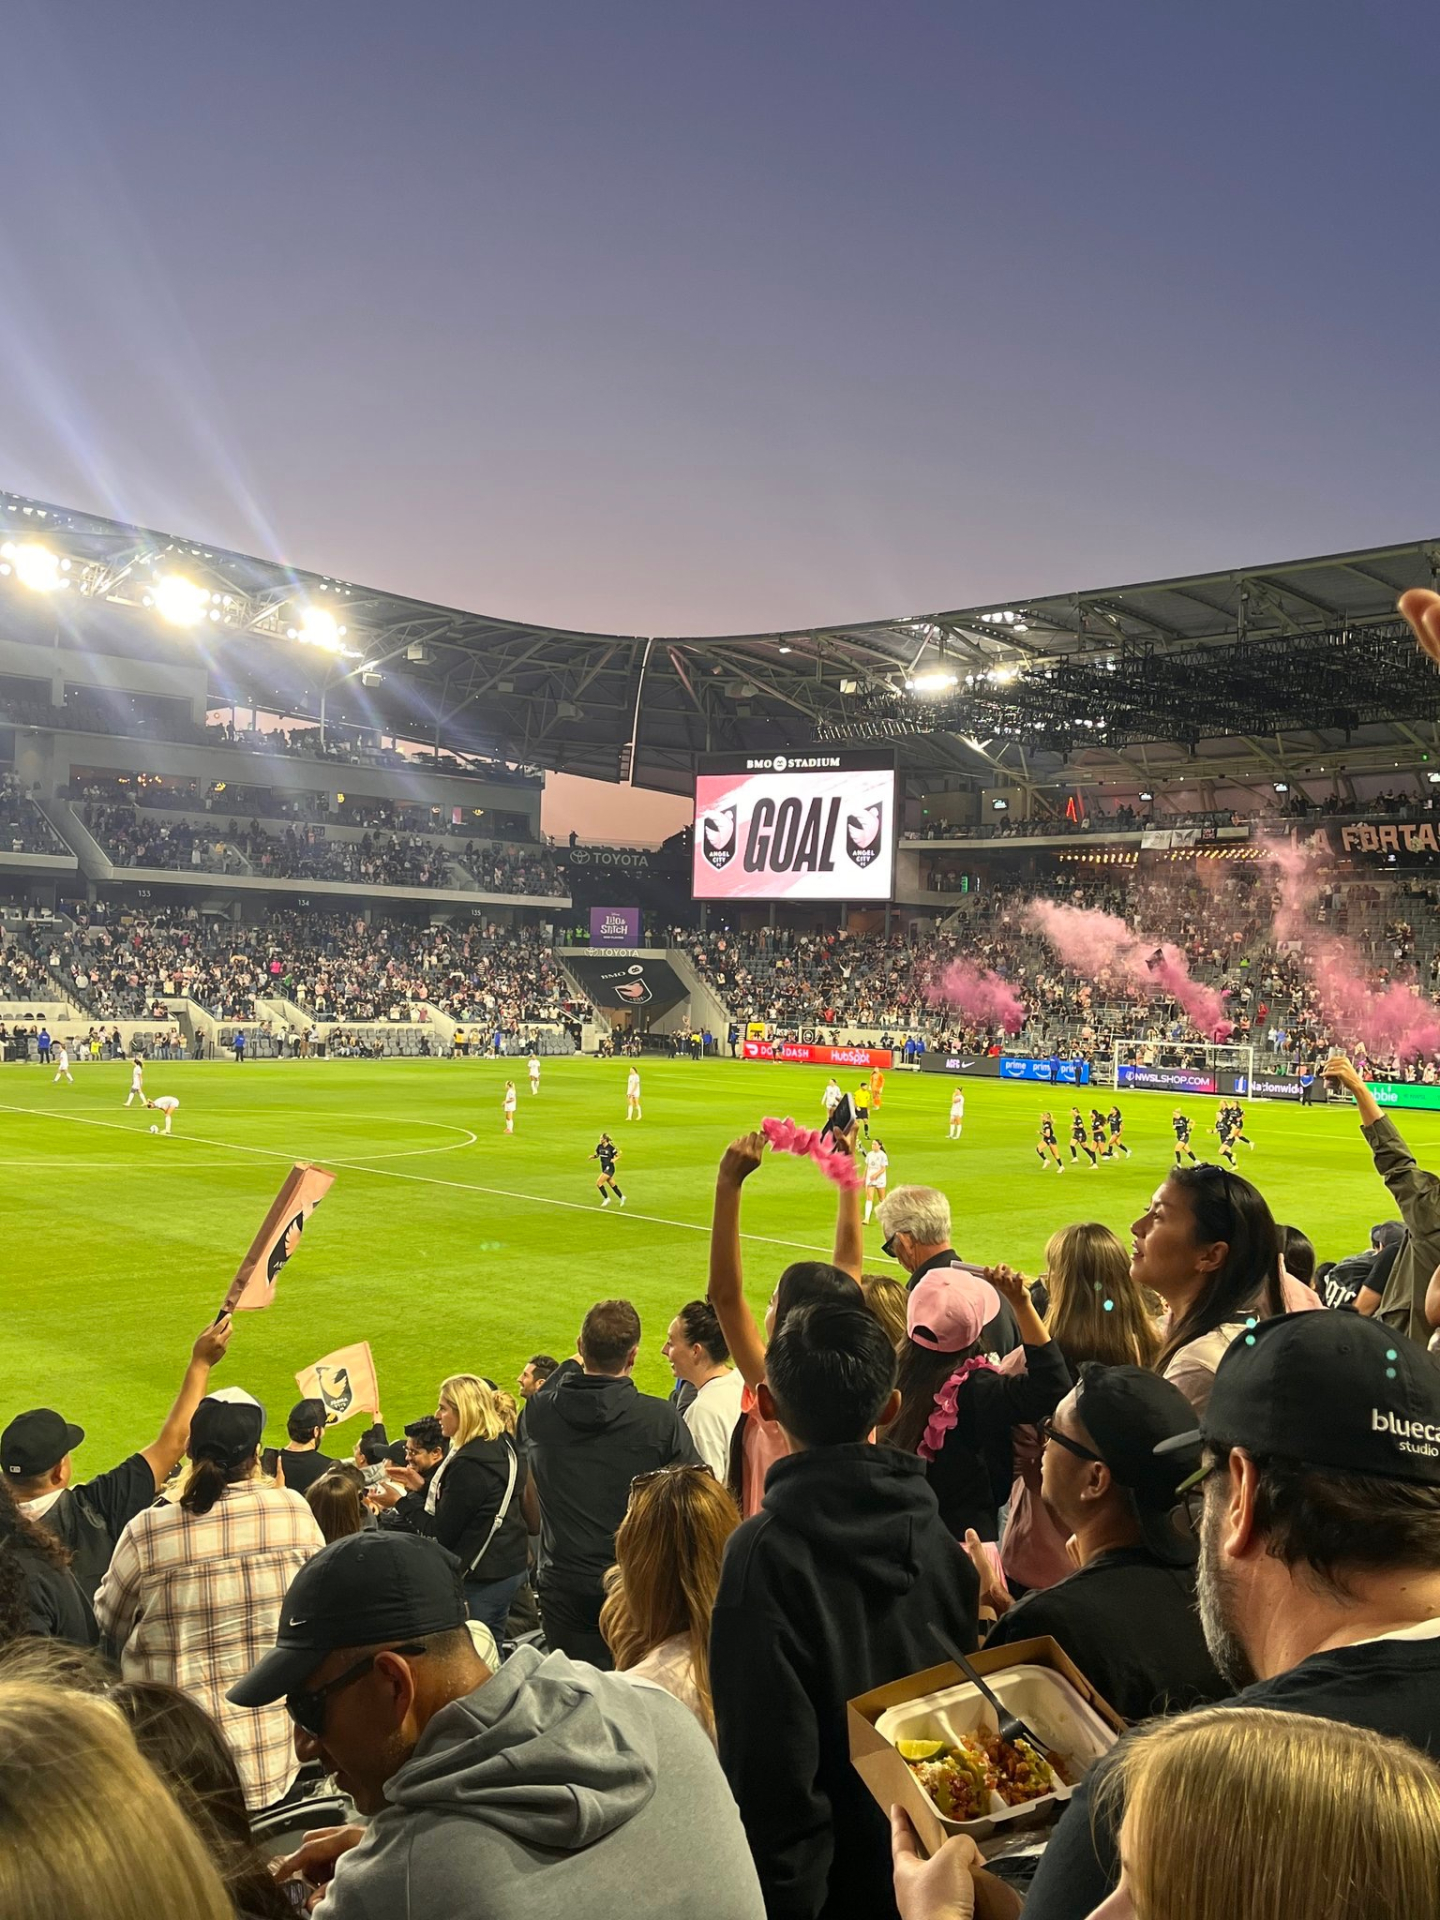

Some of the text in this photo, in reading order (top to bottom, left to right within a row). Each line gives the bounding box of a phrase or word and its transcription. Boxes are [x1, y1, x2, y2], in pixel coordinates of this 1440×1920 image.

[746, 757, 840, 769] BMO STADIUM
[743, 796, 842, 873] GOAL
[1291, 823, 1440, 857] LA FORTA
[592, 852, 649, 867] TOYOTA
[600, 948, 639, 957] TOYOTA
[601, 971, 626, 980] BMO
[760, 1045, 809, 1058] DORDASH
[831, 1049, 870, 1065] HubSpot
[1005, 1060, 1026, 1071] prime
[1033, 1062, 1051, 1073] prim
[1134, 1073, 1210, 1086] NWSLSHOP.COM
[1371, 1085, 1398, 1102] bbie
